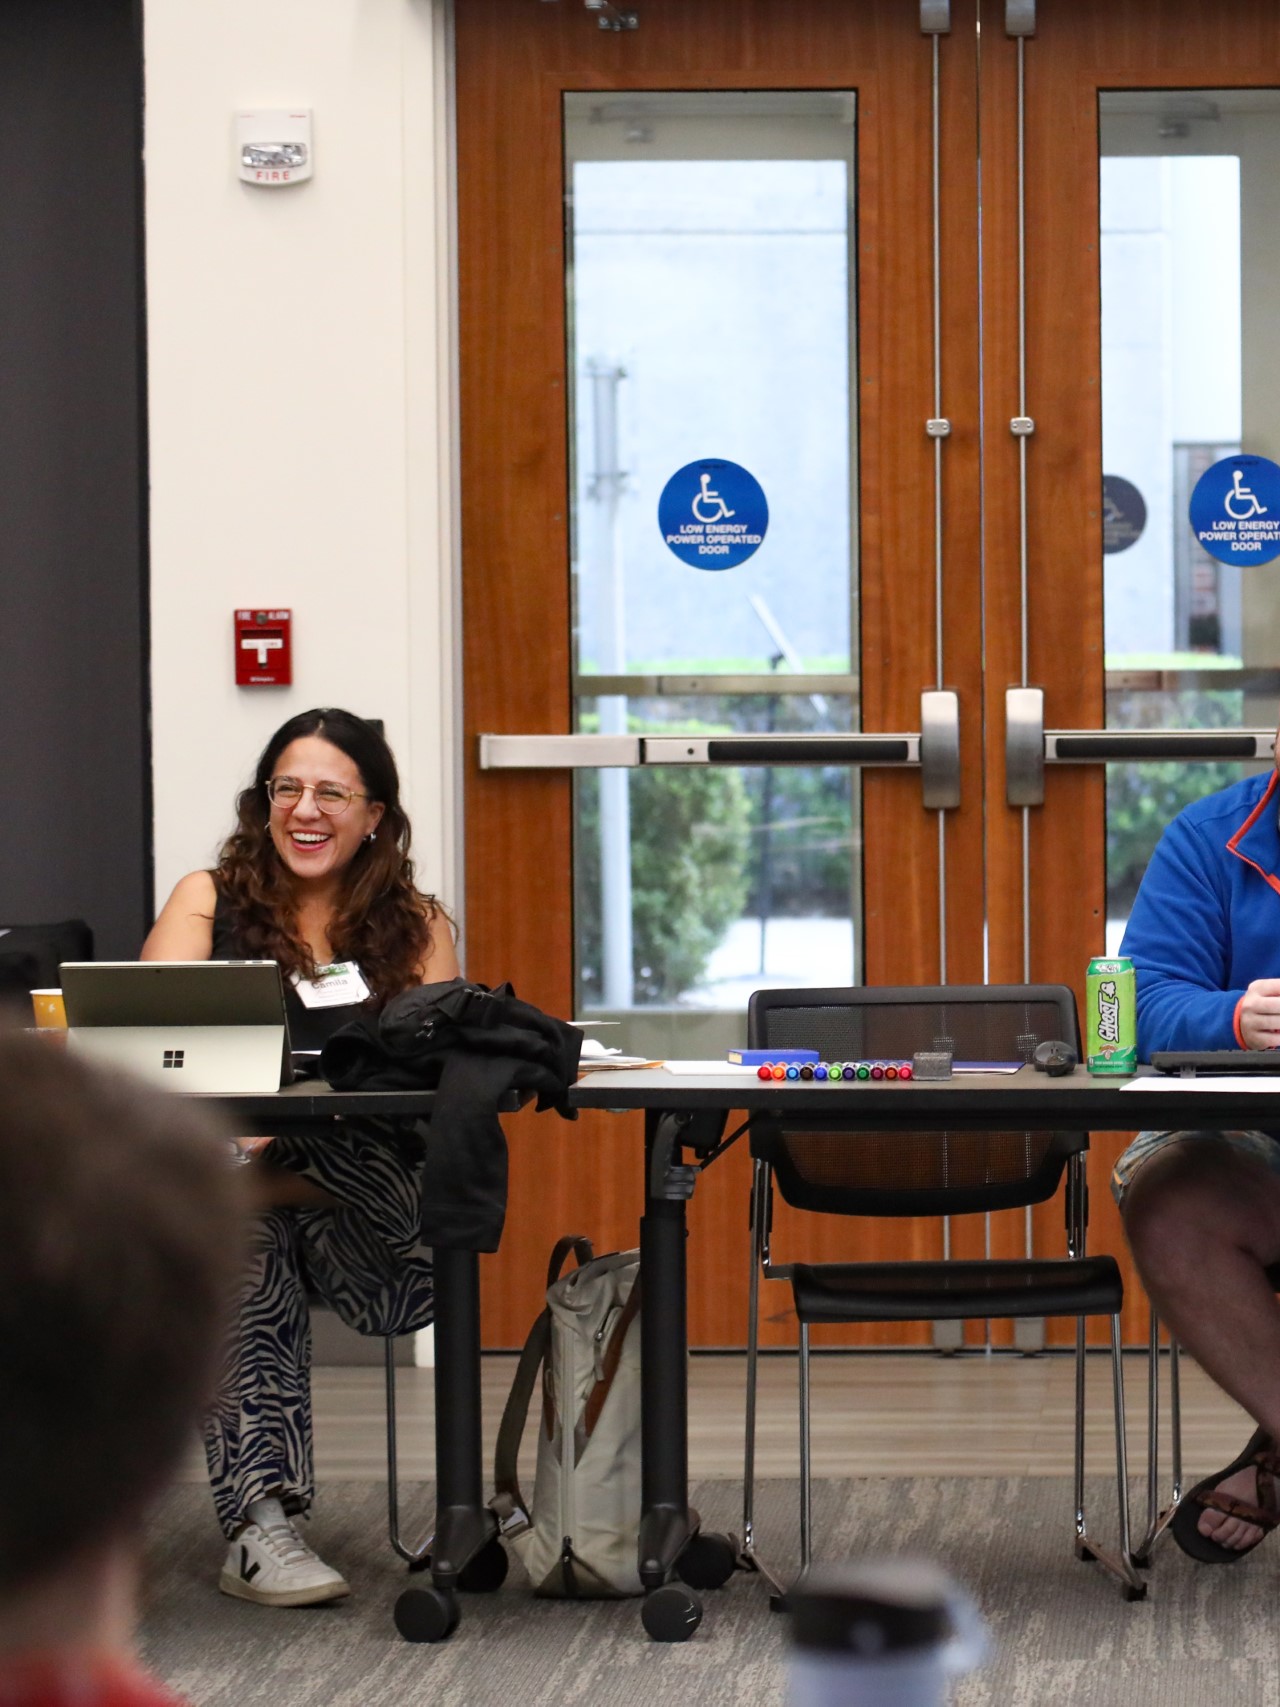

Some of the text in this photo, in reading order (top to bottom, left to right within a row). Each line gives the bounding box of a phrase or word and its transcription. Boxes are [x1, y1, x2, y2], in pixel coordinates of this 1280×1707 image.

[256, 170, 291, 181] FIRE
[680, 524, 748, 533] LOW ENERGY
[1212, 521, 1280, 530] LOW ENERGY
[666, 535, 762, 544] POWER OPERATED
[1199, 531, 1237, 541] POWER
[698, 545, 730, 554] DOOR
[1231, 542, 1262, 551] DOOR
[311, 979, 348, 990] Camila
[1098, 990, 1120, 1043] GHOST
